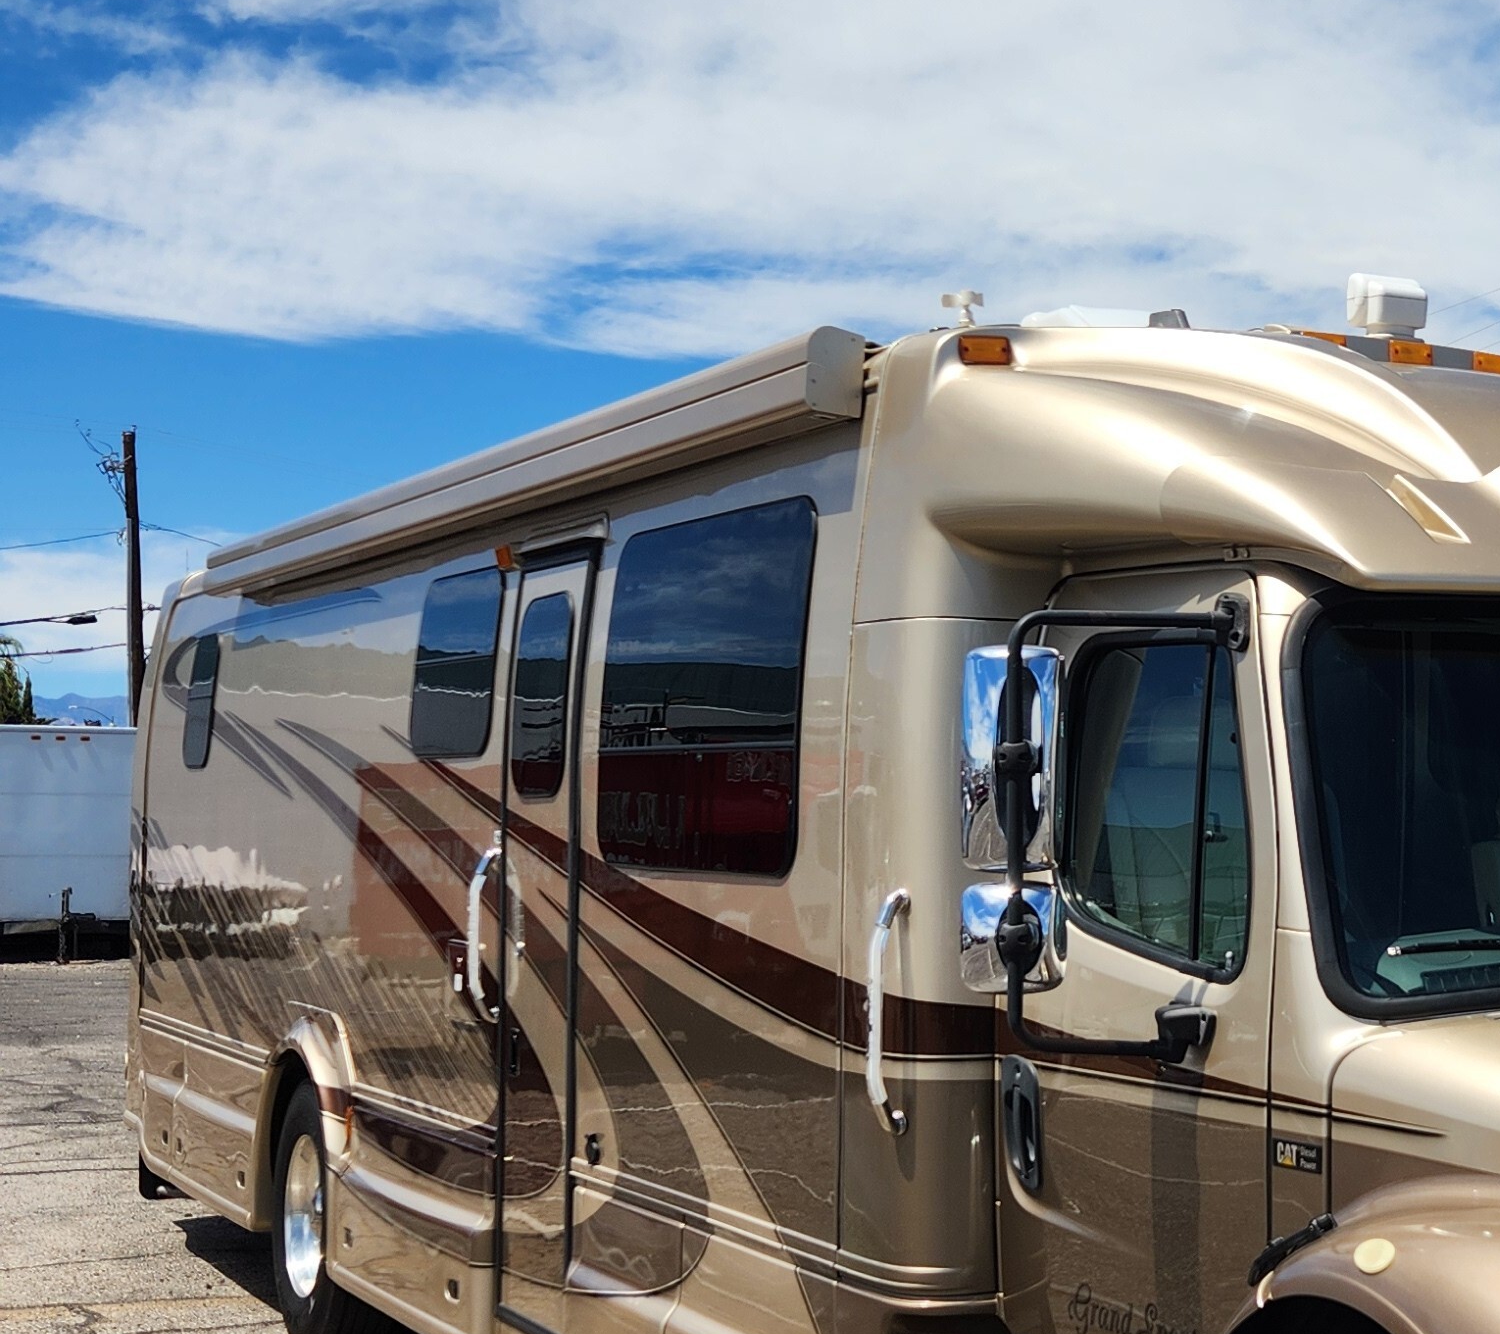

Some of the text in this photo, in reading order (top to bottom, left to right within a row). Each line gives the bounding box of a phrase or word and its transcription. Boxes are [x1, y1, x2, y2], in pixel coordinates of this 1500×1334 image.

[1276, 1141, 1298, 1166] CAT
[1300, 1146, 1317, 1158] Diesel
[1300, 1157, 1317, 1170] Power
